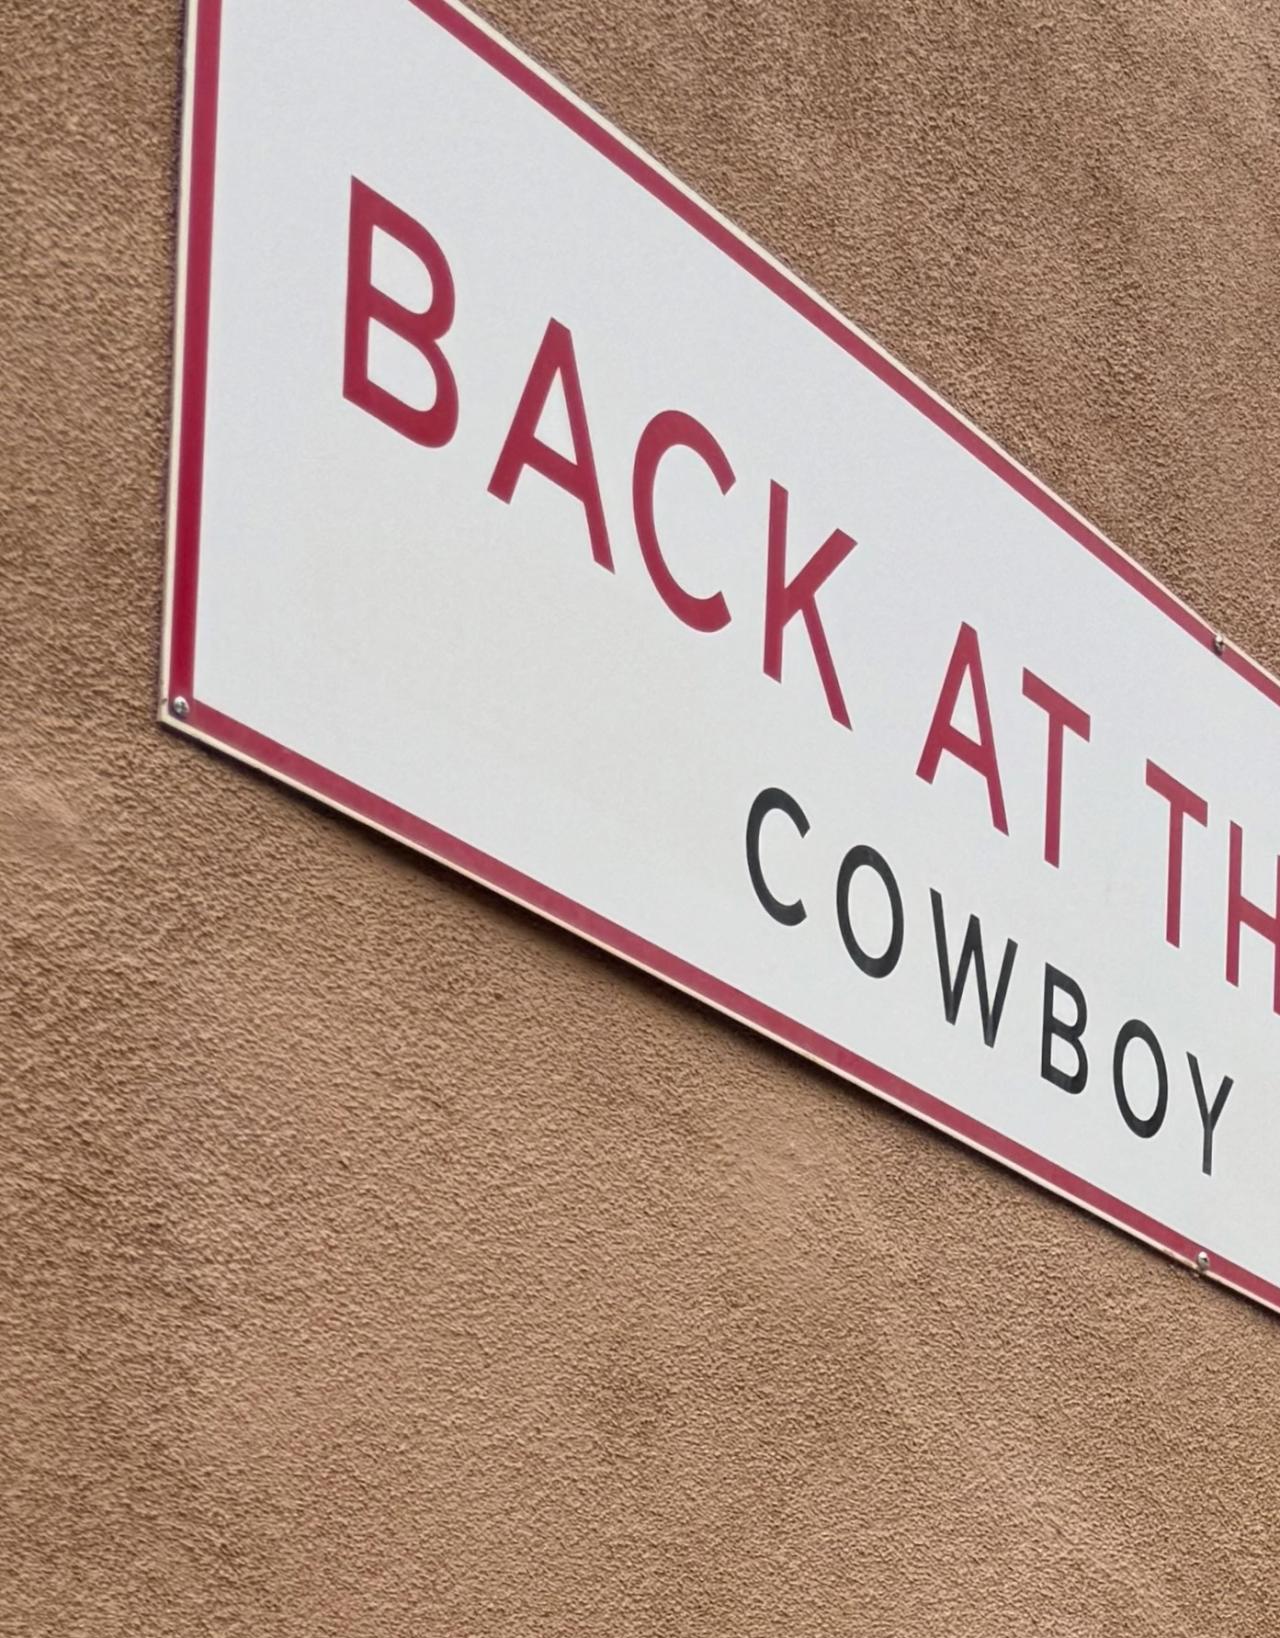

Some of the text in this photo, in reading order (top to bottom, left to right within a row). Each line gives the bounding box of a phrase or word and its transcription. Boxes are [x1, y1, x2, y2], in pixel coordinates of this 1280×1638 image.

[342, 175, 858, 730] BACK
[915, 621, 1091, 868] AT
[745, 787, 1234, 1176] COWBOY
